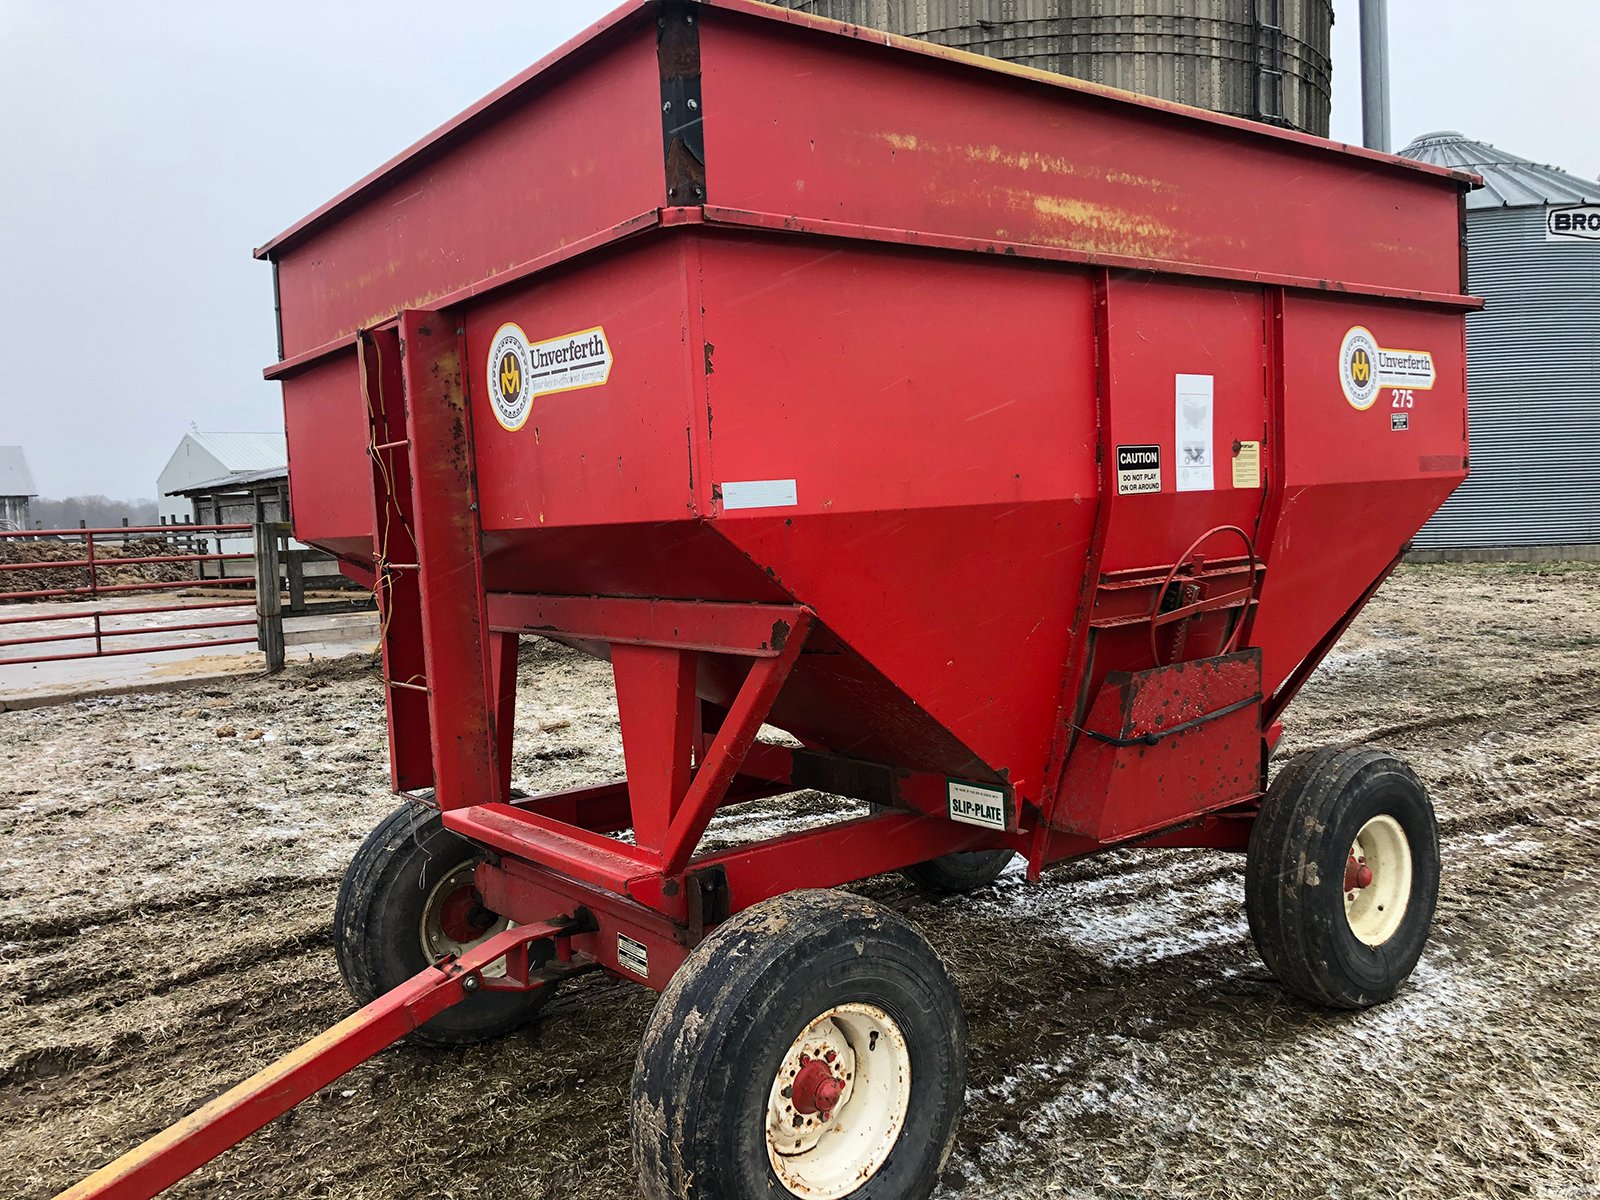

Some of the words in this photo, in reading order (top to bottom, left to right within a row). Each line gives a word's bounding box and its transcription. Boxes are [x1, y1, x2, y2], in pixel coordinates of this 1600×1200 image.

[529, 334, 605, 370] Unverferth
[1378, 352, 1431, 371] Unverferth
[1391, 389, 1413, 408] 275
[1120, 452, 1157, 465] CAUTION
[1120, 484, 1129, 492] ON
[1129, 483, 1137, 491] OR
[1138, 482, 1159, 491] AROUND
[1122, 474, 1131, 482] DO
[1144, 473, 1157, 481] PLAY
[952, 798, 1002, 821] SLIP-PLATE
